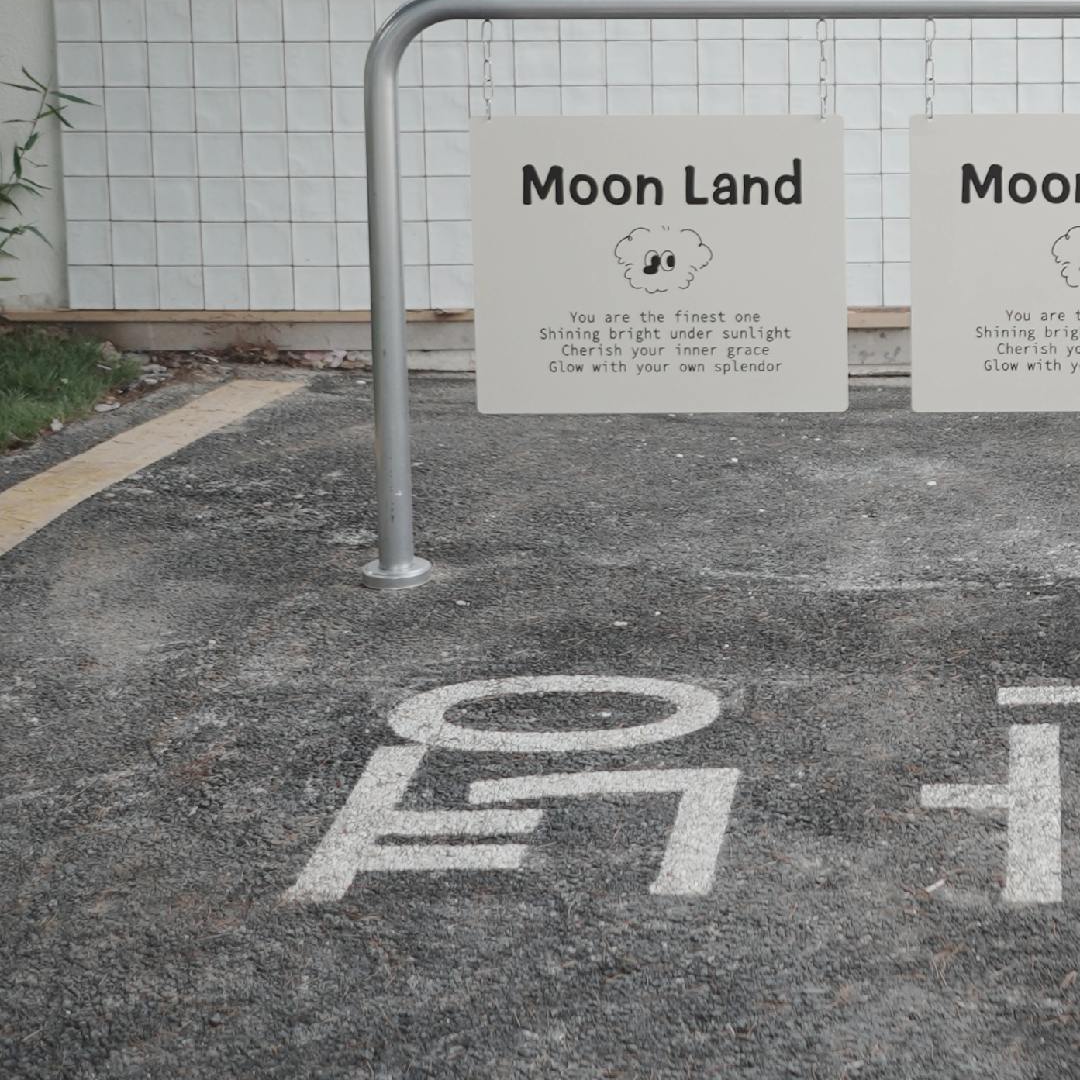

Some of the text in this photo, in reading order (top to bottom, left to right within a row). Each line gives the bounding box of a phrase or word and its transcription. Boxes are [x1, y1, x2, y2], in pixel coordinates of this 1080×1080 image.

[521, 157, 803, 206] Moon Land
[570, 309, 761, 324] You are the finest one
[1005, 310, 1031, 322] You
[1040, 311, 1065, 322] are
[539, 325, 791, 344] Shining bright under sunlight
[975, 325, 1036, 342] Shining
[561, 343, 770, 360] Cherish your inner grace
[996, 342, 1057, 355] Cherish
[548, 359, 782, 376] Glow with your own splendor
[983, 358, 1019, 372] Glow
[1026, 358, 1062, 372] with
